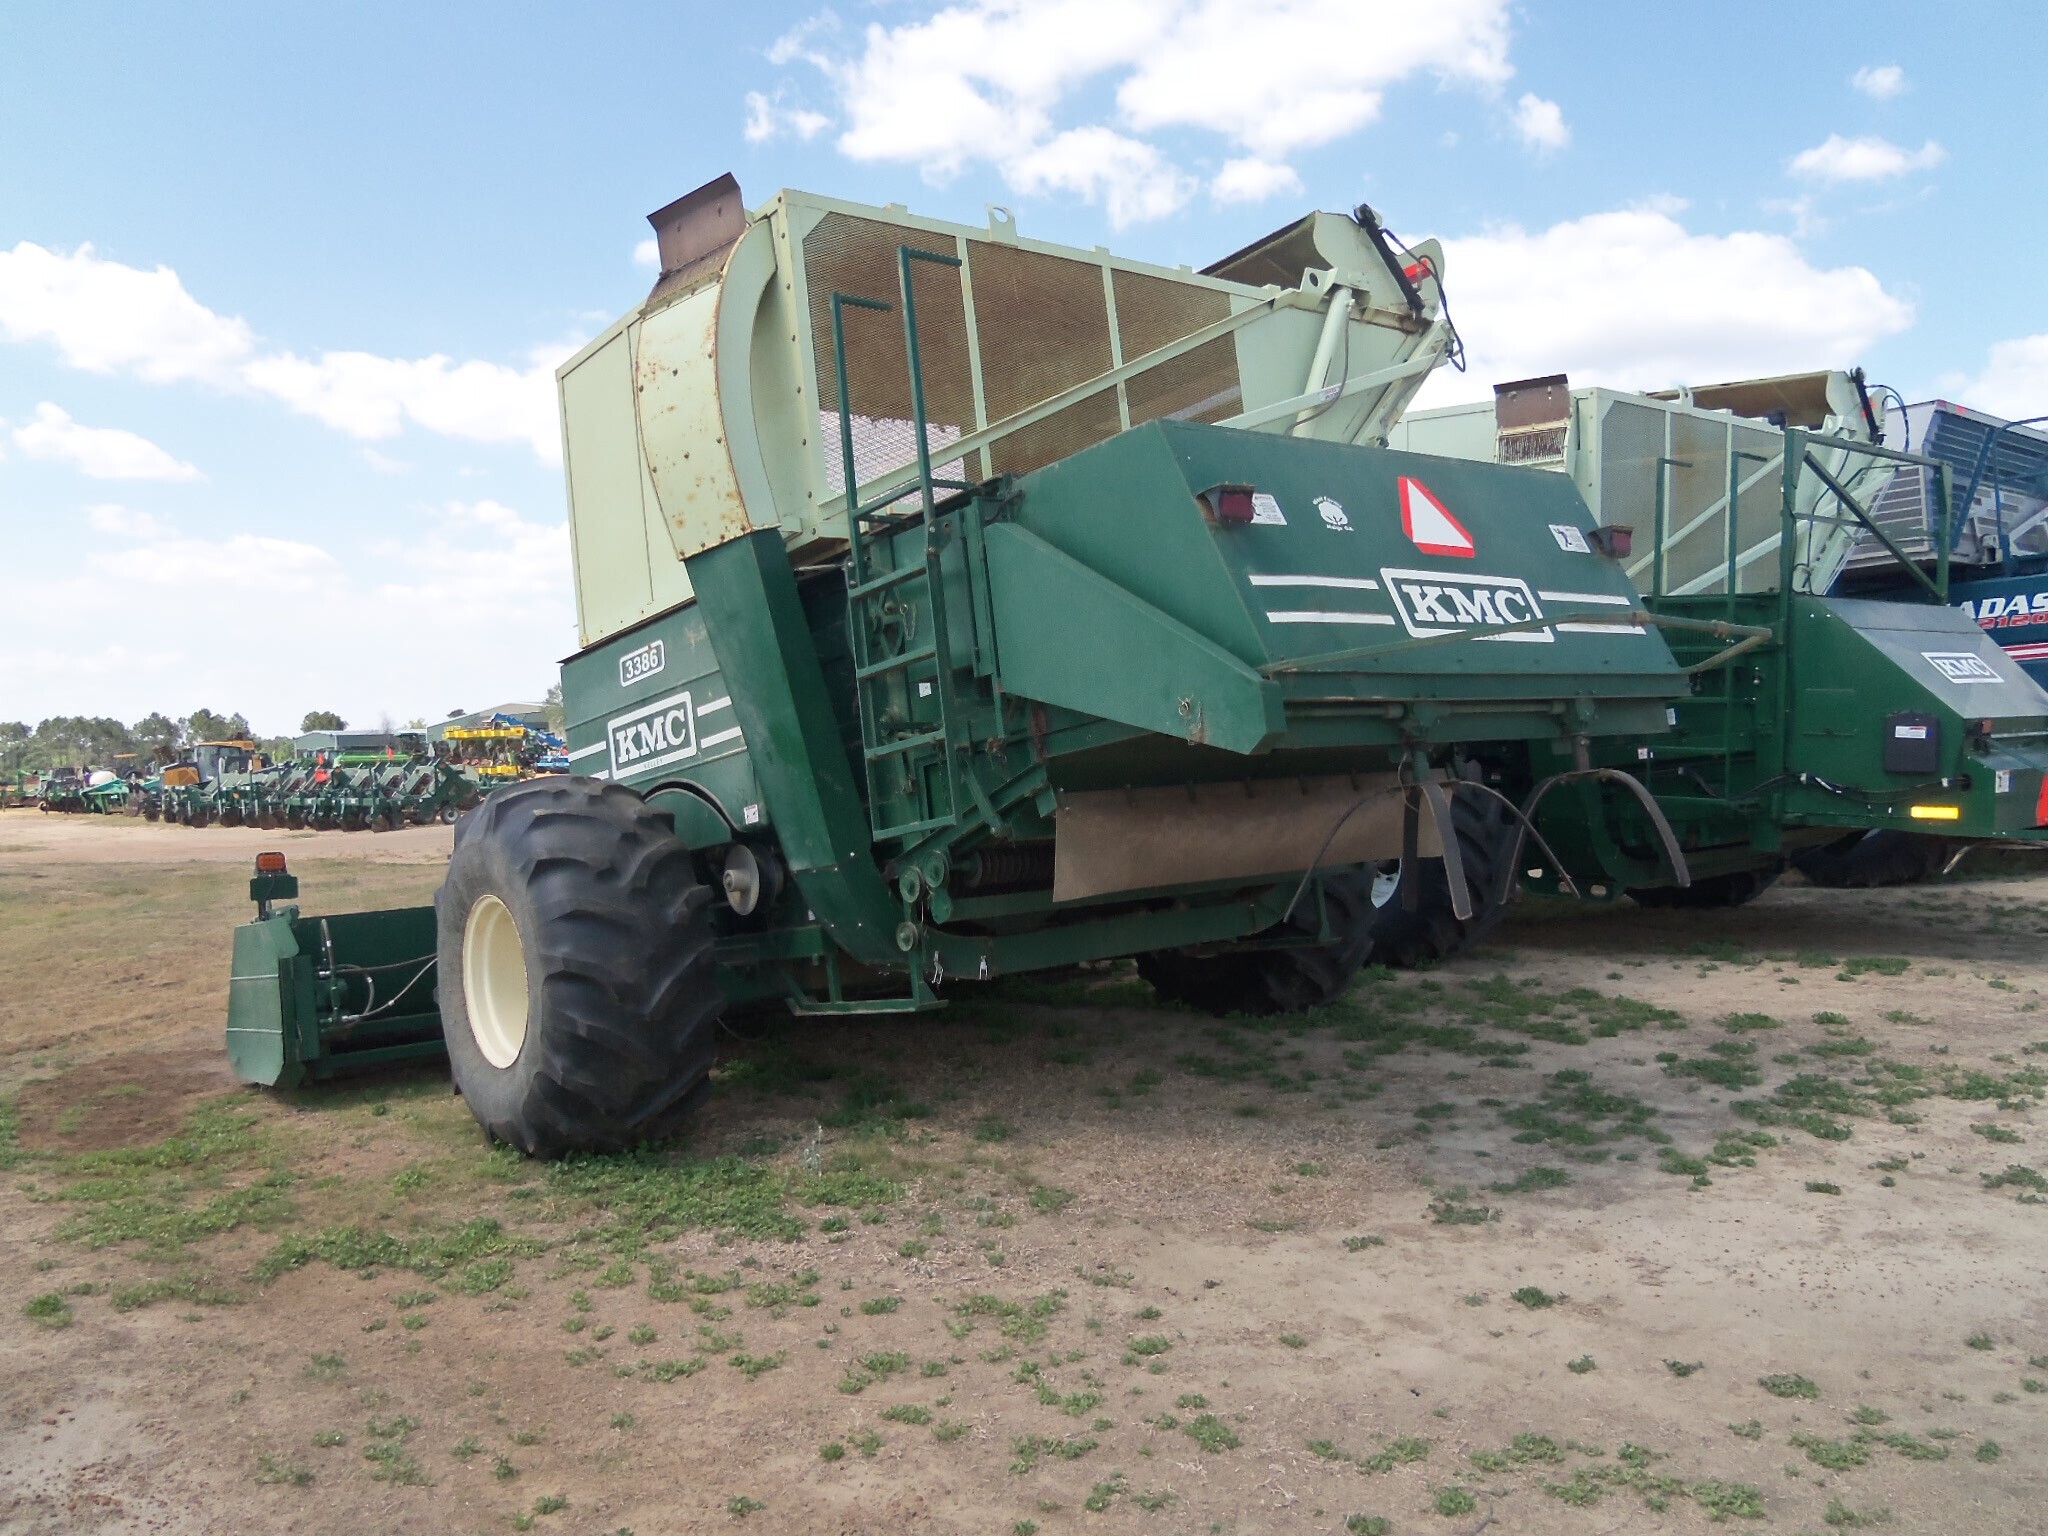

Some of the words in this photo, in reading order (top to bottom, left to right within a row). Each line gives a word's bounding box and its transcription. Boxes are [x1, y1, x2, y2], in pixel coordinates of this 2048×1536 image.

[1401, 584, 1531, 625] KMC
[625, 649, 659, 679] 3386
[1932, 658, 1991, 677] KMC
[616, 708, 687, 764] KMC
